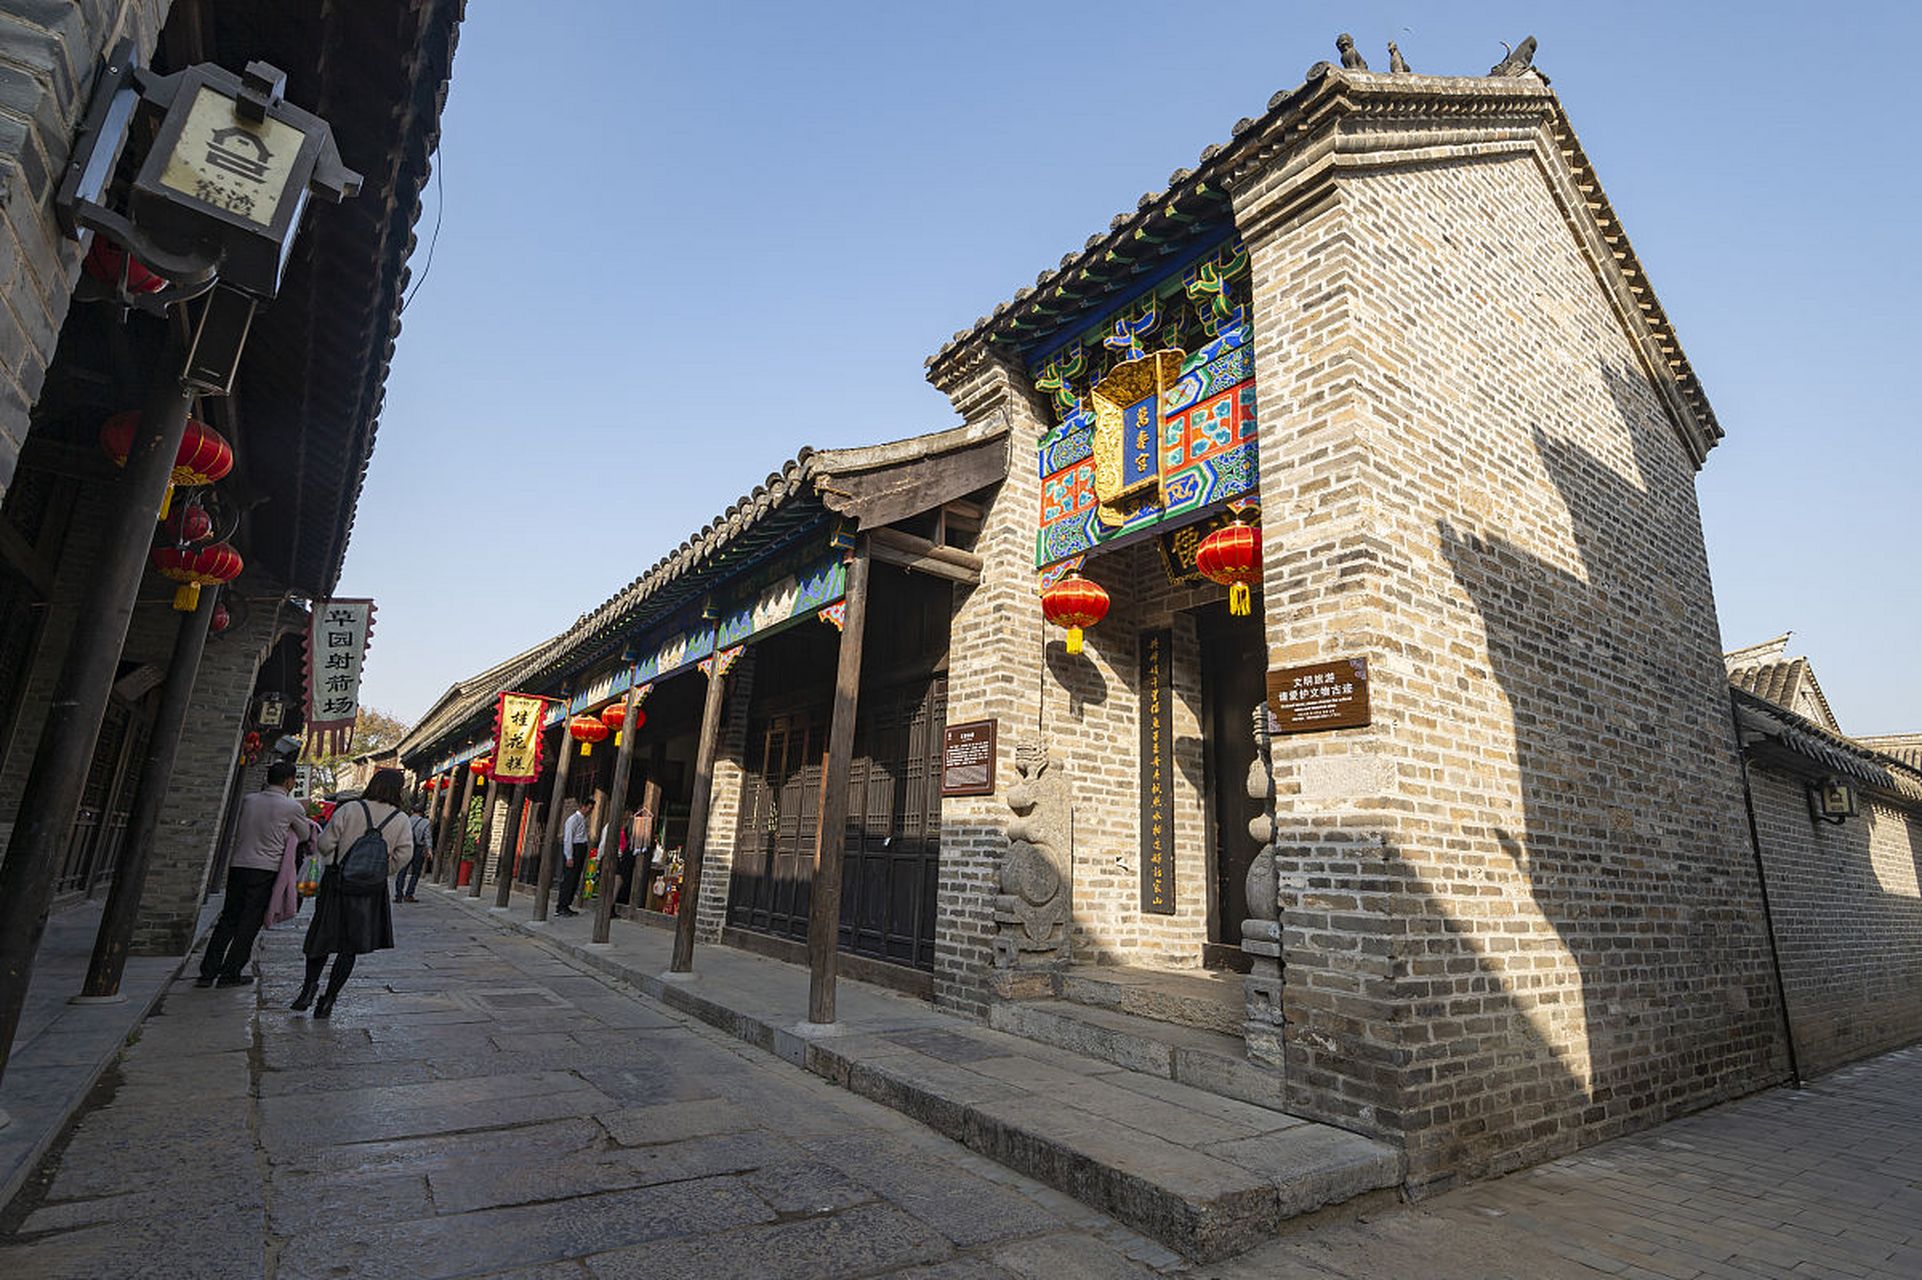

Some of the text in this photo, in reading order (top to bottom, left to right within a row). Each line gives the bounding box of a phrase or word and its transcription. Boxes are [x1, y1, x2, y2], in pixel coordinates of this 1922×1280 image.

[1293, 672, 1335, 688] 文明旅游
[505, 710, 528, 773] 桂花糕
